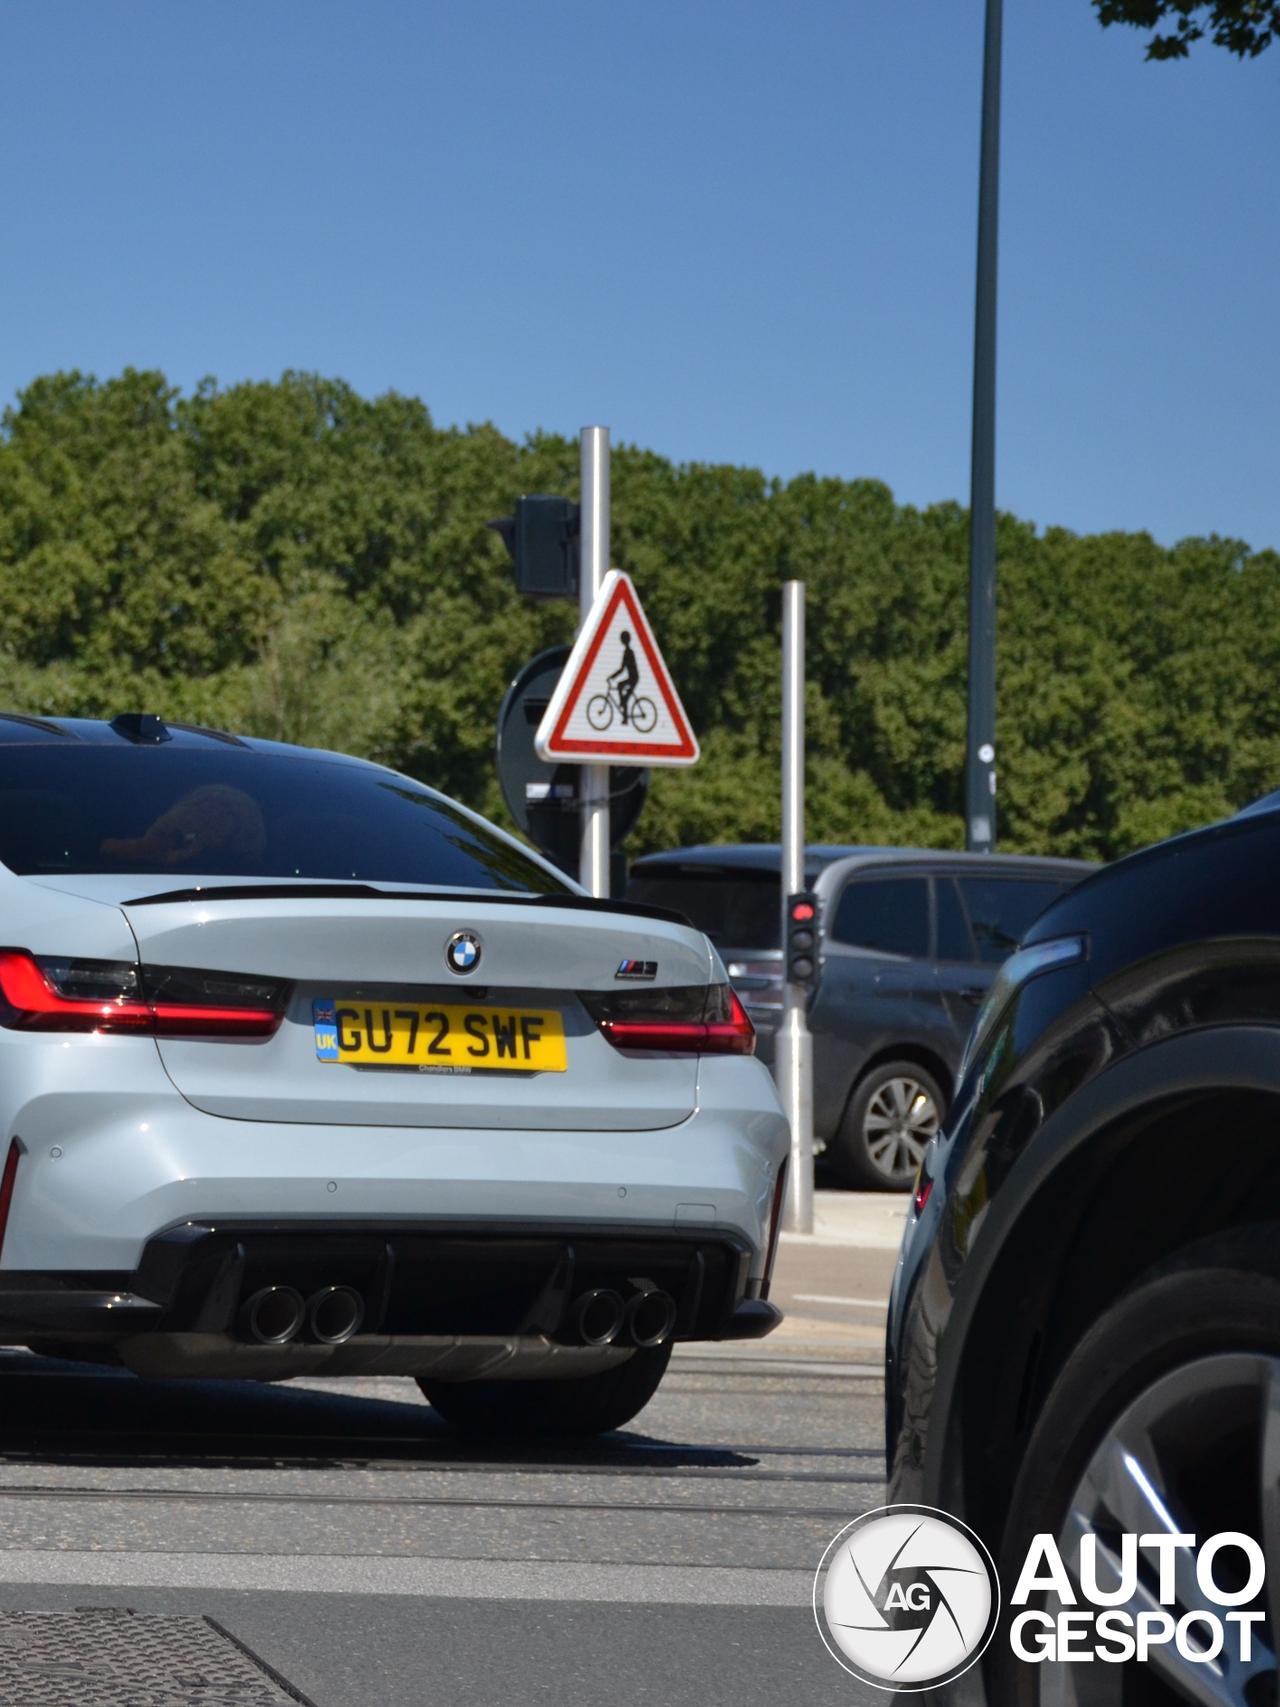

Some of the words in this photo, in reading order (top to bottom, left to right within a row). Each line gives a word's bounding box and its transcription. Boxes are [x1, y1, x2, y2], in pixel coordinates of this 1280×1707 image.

[316, 1033, 337, 1050] UK
[336, 1008, 452, 1056] GU72
[464, 1013, 545, 1060] SWF
